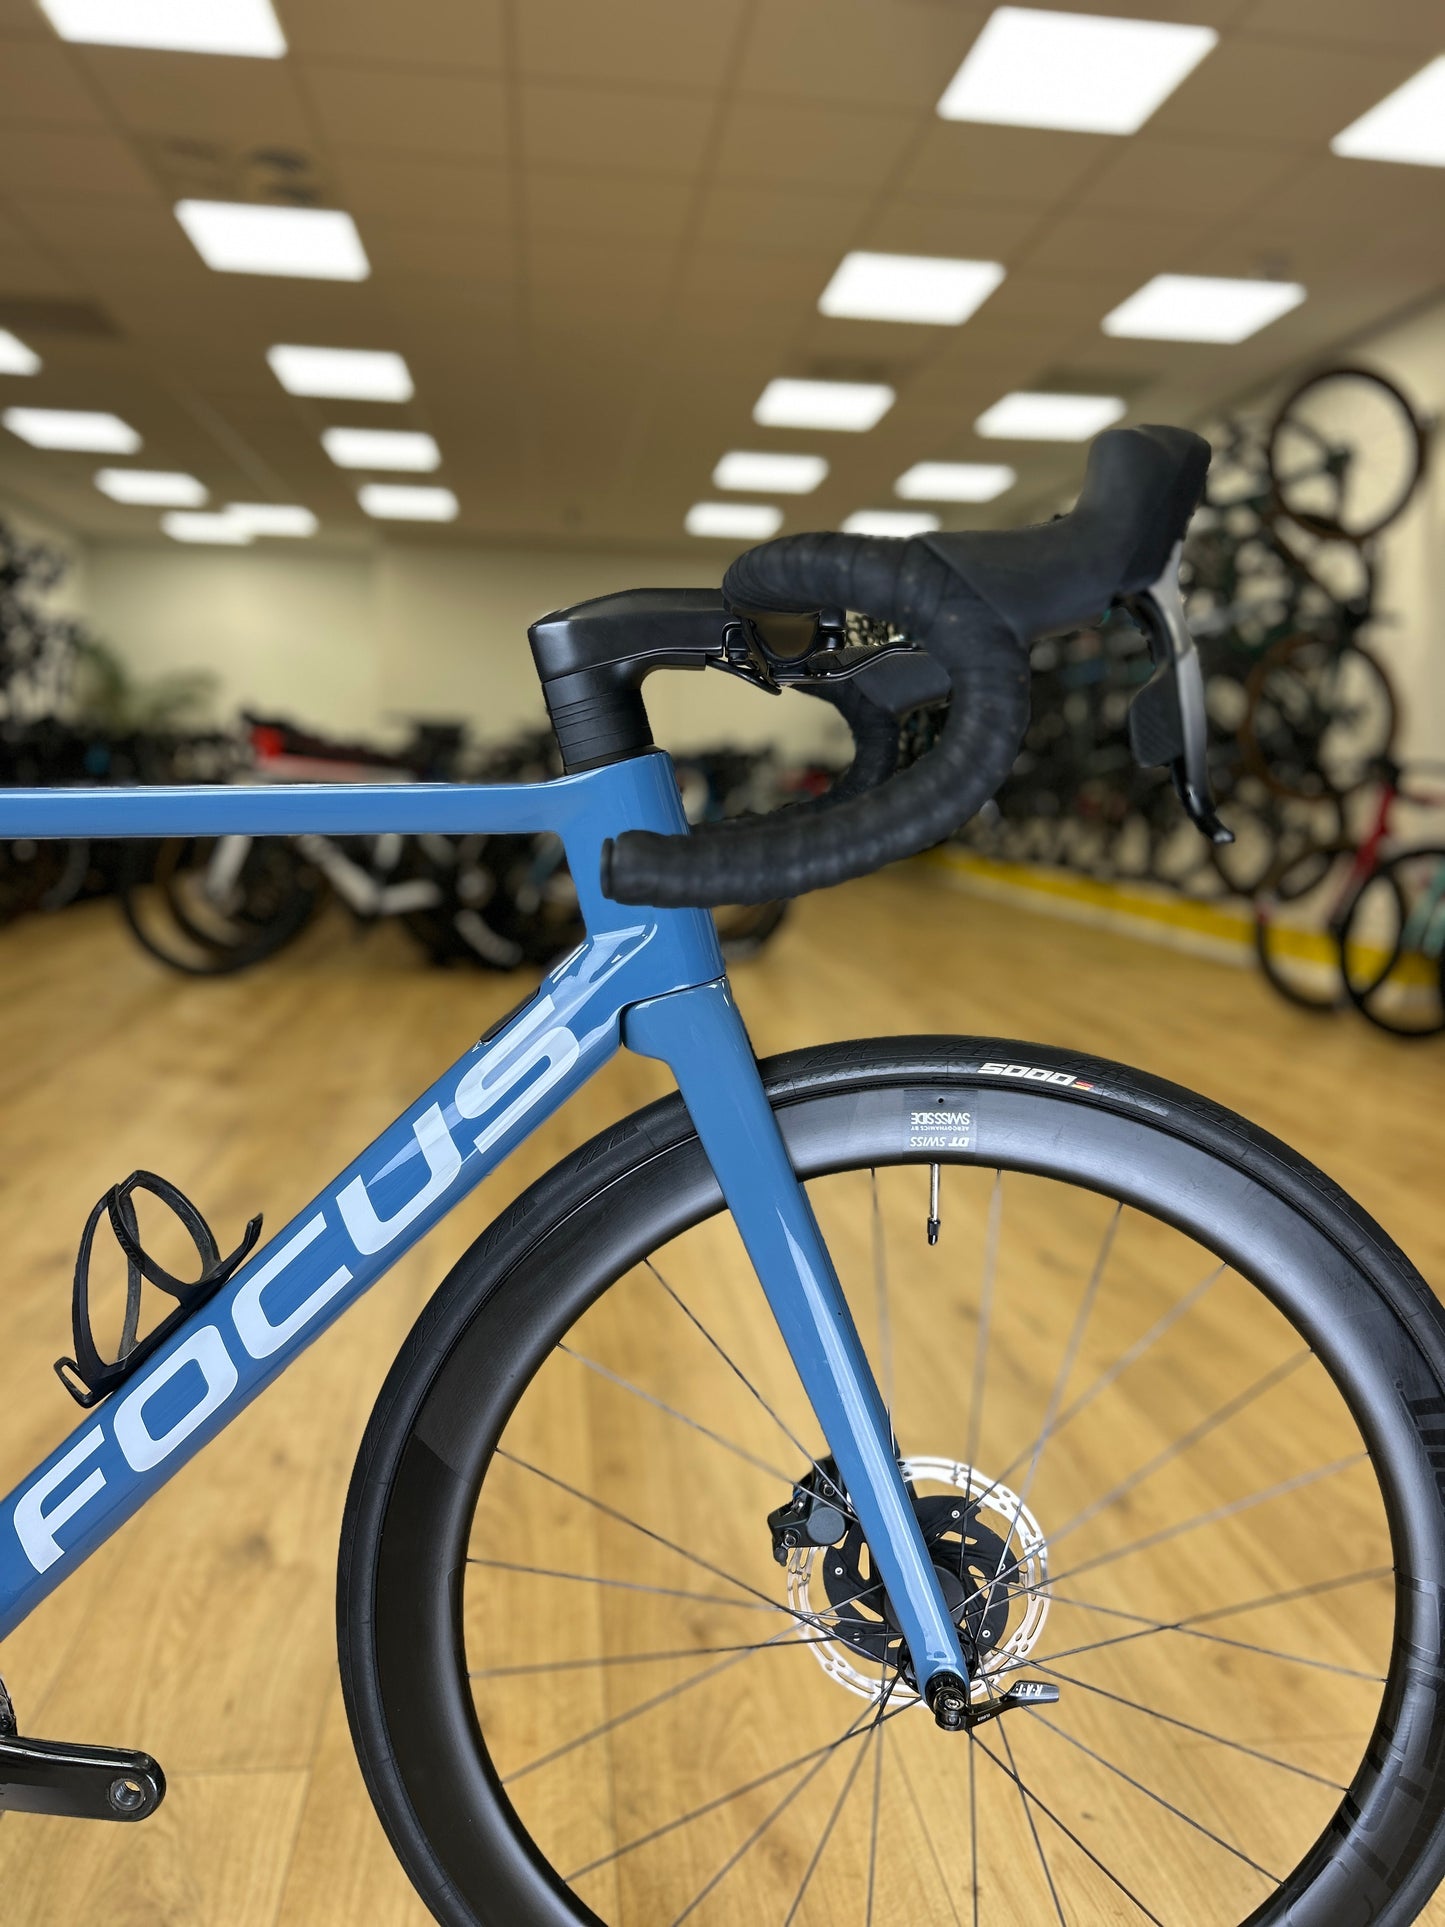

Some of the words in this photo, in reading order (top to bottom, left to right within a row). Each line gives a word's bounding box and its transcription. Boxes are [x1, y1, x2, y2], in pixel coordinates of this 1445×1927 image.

[977, 1062, 1077, 1086] 5000
[910, 1136, 947, 1147] SWISS
[948, 1136, 970, 1147] DT
[13, 996, 580, 1574] FOCUS
